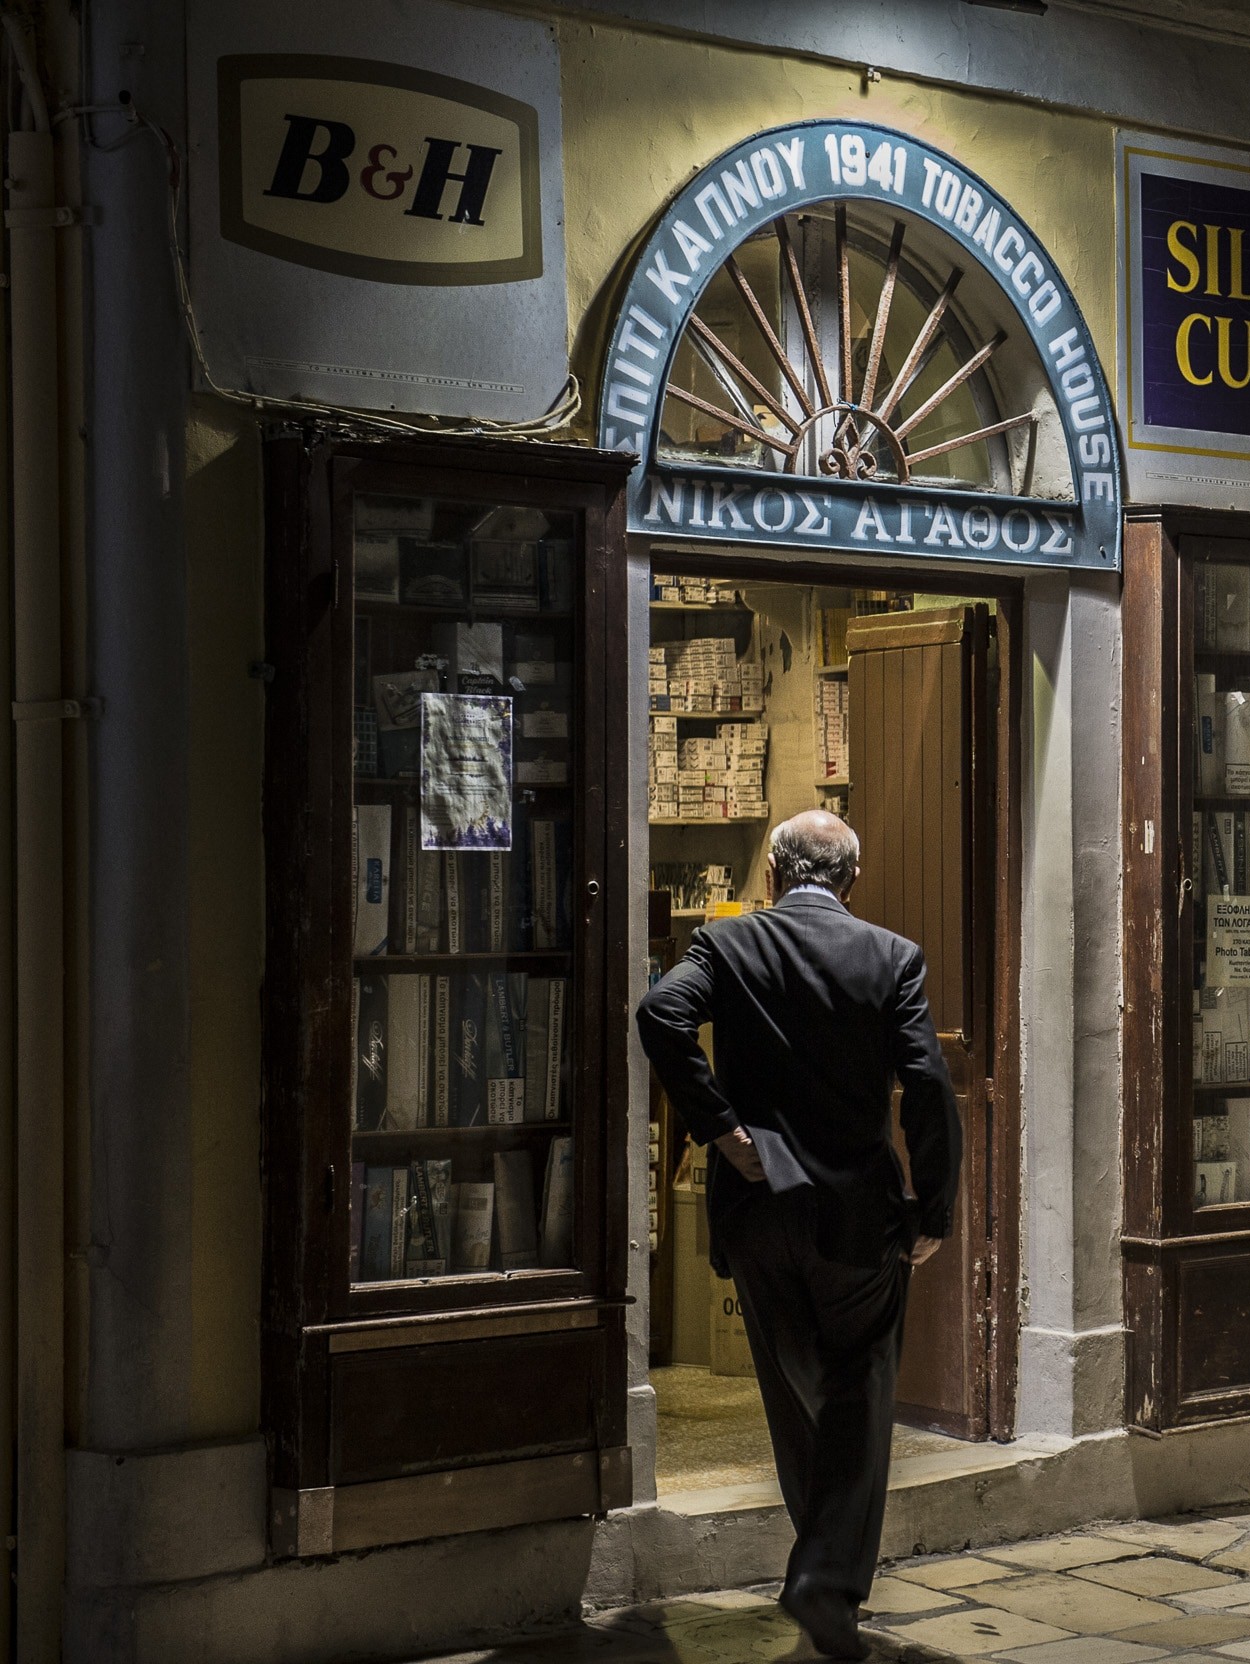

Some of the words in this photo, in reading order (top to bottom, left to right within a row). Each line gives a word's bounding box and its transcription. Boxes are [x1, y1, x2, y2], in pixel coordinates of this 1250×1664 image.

[263, 113, 503, 227] B&H
[605, 304, 669, 465] ΣΠΙΤΙ
[645, 136, 806, 305] ΚΑΠΝΟΥ
[823, 132, 907, 196] 1941
[921, 156, 1062, 328] TOBACCO
[1047, 328, 1116, 502] HOUSE
[642, 474, 832, 535] ΝΙΚΟΣ
[850, 495, 1075, 556] ΑΓΑΘΟΣ
[461, 676, 495, 687] Captain
[465, 685, 493, 695] Black
[1213, 917, 1231, 929] ΤΩΝ
[1215, 947, 1238, 957] Photo
[551, 980, 563, 1016] πρόωρα
[496, 979, 510, 1025] LAMBERT
[503, 1033, 515, 1072] BUTLER
[550, 1016, 560, 1063] πεθαίνουν
[549, 1063, 560, 1108] καπνιστές
[547, 1109, 557, 1120] Οι
[415, 1166, 428, 1208] LAMBERT
